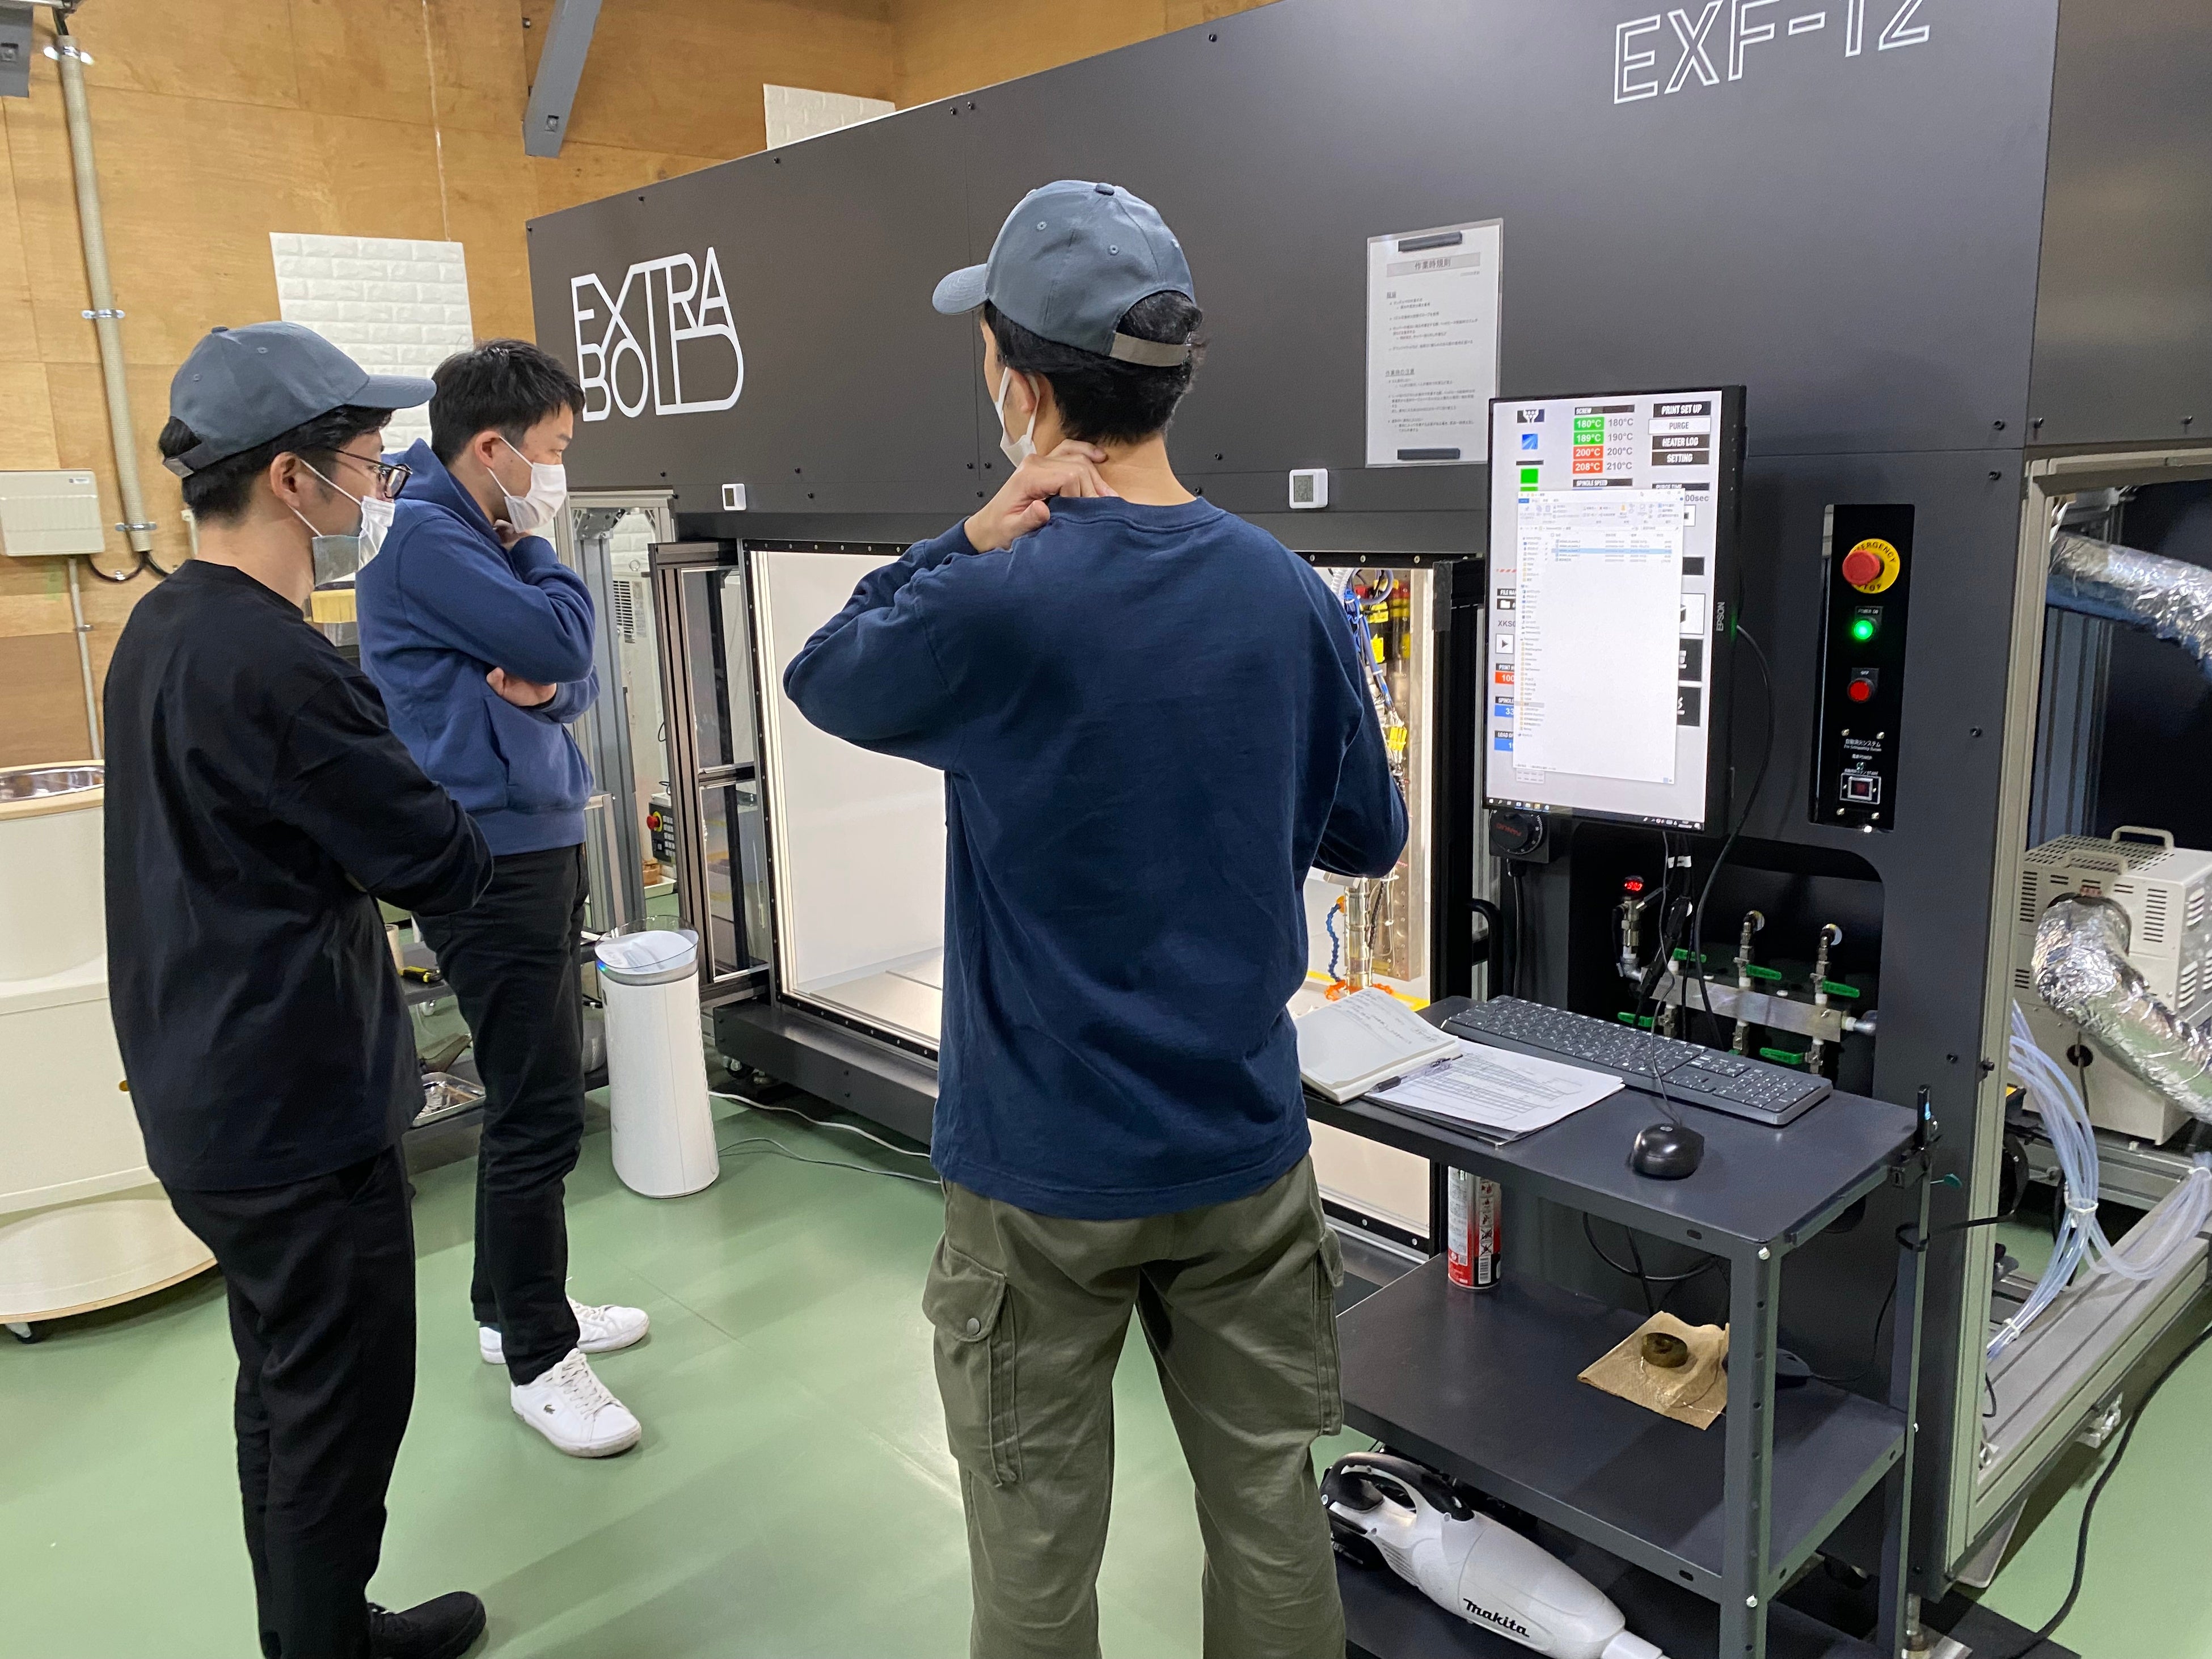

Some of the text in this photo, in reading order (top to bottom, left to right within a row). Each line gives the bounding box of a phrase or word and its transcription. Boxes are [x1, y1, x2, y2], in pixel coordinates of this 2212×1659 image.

[1614, 0, 1930, 104] EXF-12
[571, 246, 733, 351] EXTRA
[581, 324, 744, 422] BOLD
[1661, 404, 1703, 415] PRINT SET UP
[1577, 417, 1634, 428] 180°C 180°C
[1669, 421, 1690, 430] PURGE
[1576, 432, 1633, 442] 189°C 190°C
[1662, 437, 1685, 447] HEATER
[1575, 447, 1633, 457] 200°C 200°C
[1666, 453, 1693, 463] SETTING
[1574, 461, 1632, 472] 208°C 210°C
[1855, 542, 1897, 563] ERGENCY
[1716, 601, 1725, 631] EPSON
